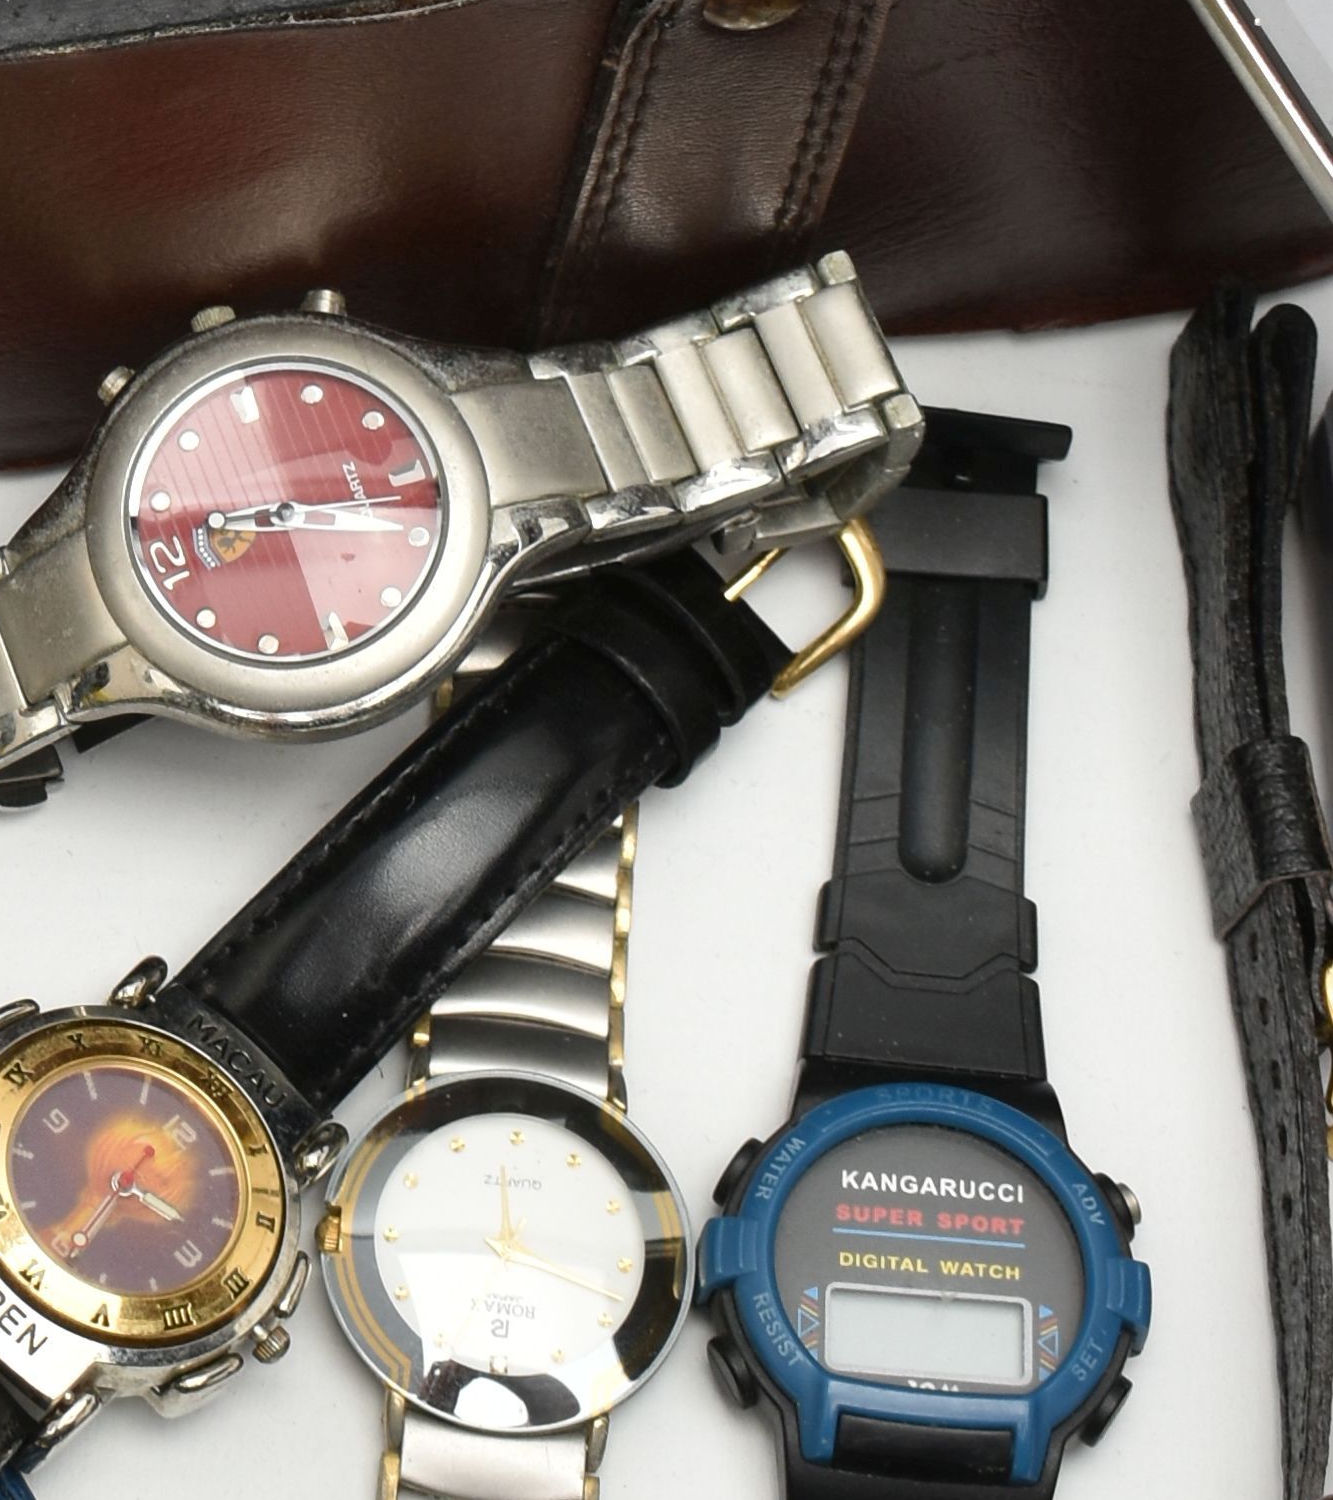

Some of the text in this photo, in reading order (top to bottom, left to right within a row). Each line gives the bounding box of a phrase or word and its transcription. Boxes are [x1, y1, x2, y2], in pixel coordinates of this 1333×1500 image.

[149, 534, 190, 593] 12
[185, 1013, 287, 1108] MACAU
[876, 1086, 995, 1113] SPORTS
[162, 1114, 199, 1148] 12
[755, 1138, 806, 1201] WATER
[841, 1169, 1025, 1204] KANGARUCCI
[835, 1203, 1025, 1235] SUPER SPORT
[1071, 1183, 1106, 1228] ADV
[839, 1251, 1021, 1281] DIGITAL WATCH
[753, 1291, 803, 1368] RESIST
[1073, 1337, 1106, 1381] SET
